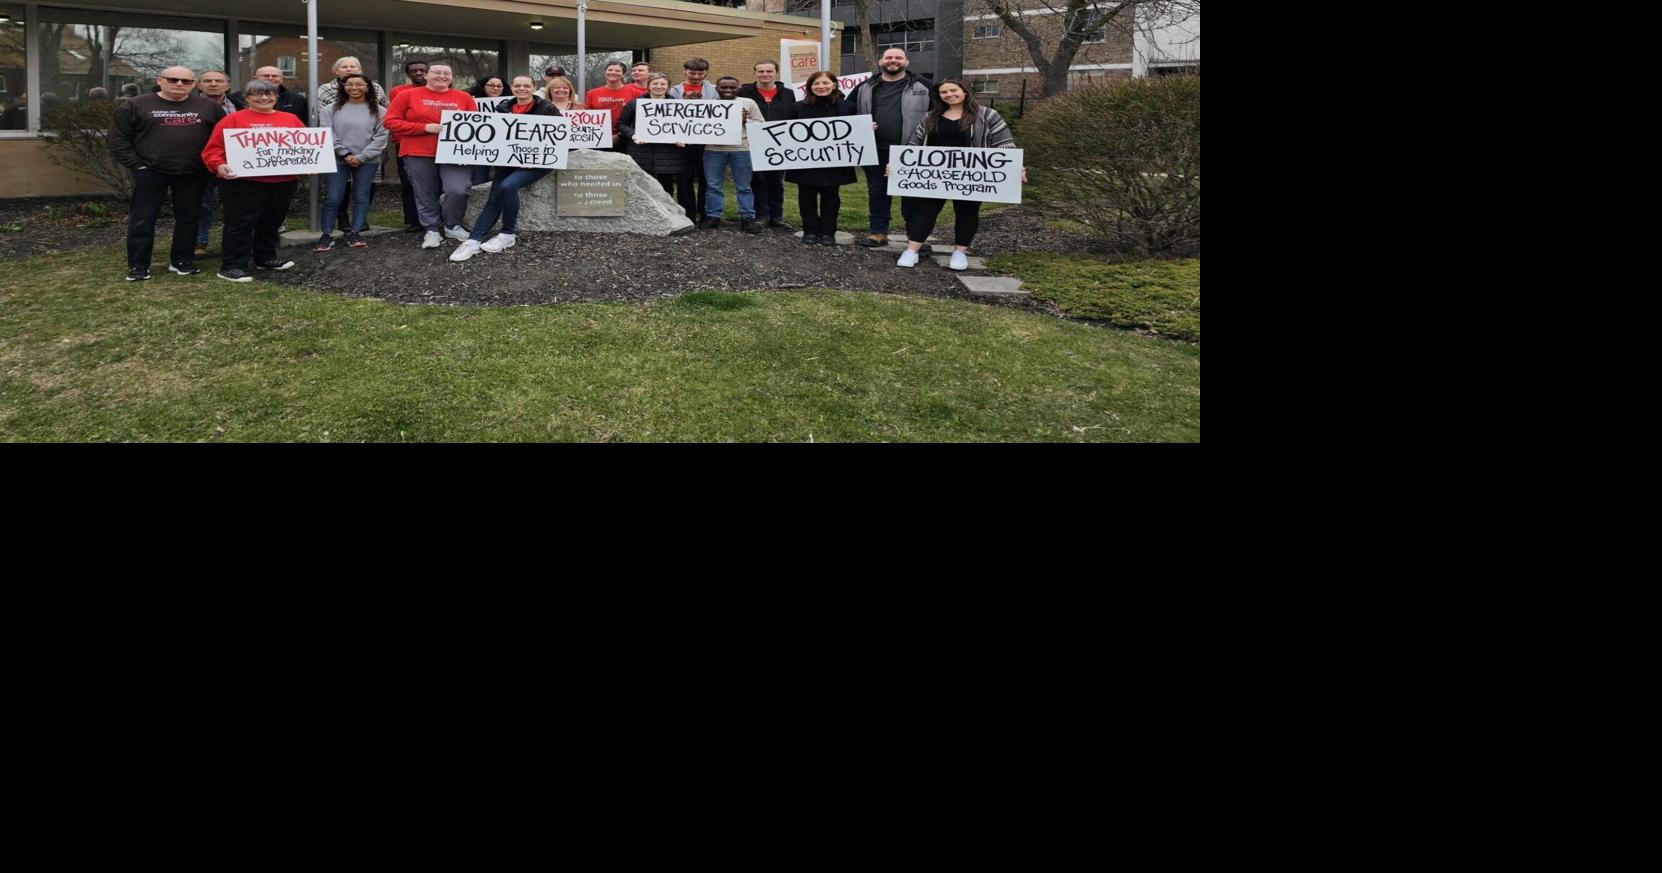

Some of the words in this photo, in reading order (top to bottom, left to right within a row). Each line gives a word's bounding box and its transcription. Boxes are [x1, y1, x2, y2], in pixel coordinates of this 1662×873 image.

[791, 57, 817, 69] care
[452, 112, 492, 123] over
[641, 102, 734, 120] EMERGENCY
[440, 120, 496, 144] 100
[502, 117, 567, 146] YEARS
[647, 118, 726, 137] Services
[762, 119, 853, 147] FOOD
[256, 147, 274, 157] for
[278, 146, 315, 158] making
[453, 143, 500, 163] Helping
[507, 143, 540, 153] Those
[543, 143, 556, 154] in
[507, 153, 559, 166] NEED
[764, 140, 865, 166] Security
[899, 148, 1013, 170] CLOTHING
[242, 160, 255, 169] a
[907, 168, 1007, 183] HOUSEHOLD
[897, 178, 938, 190] Goods
[942, 180, 998, 196] Program
